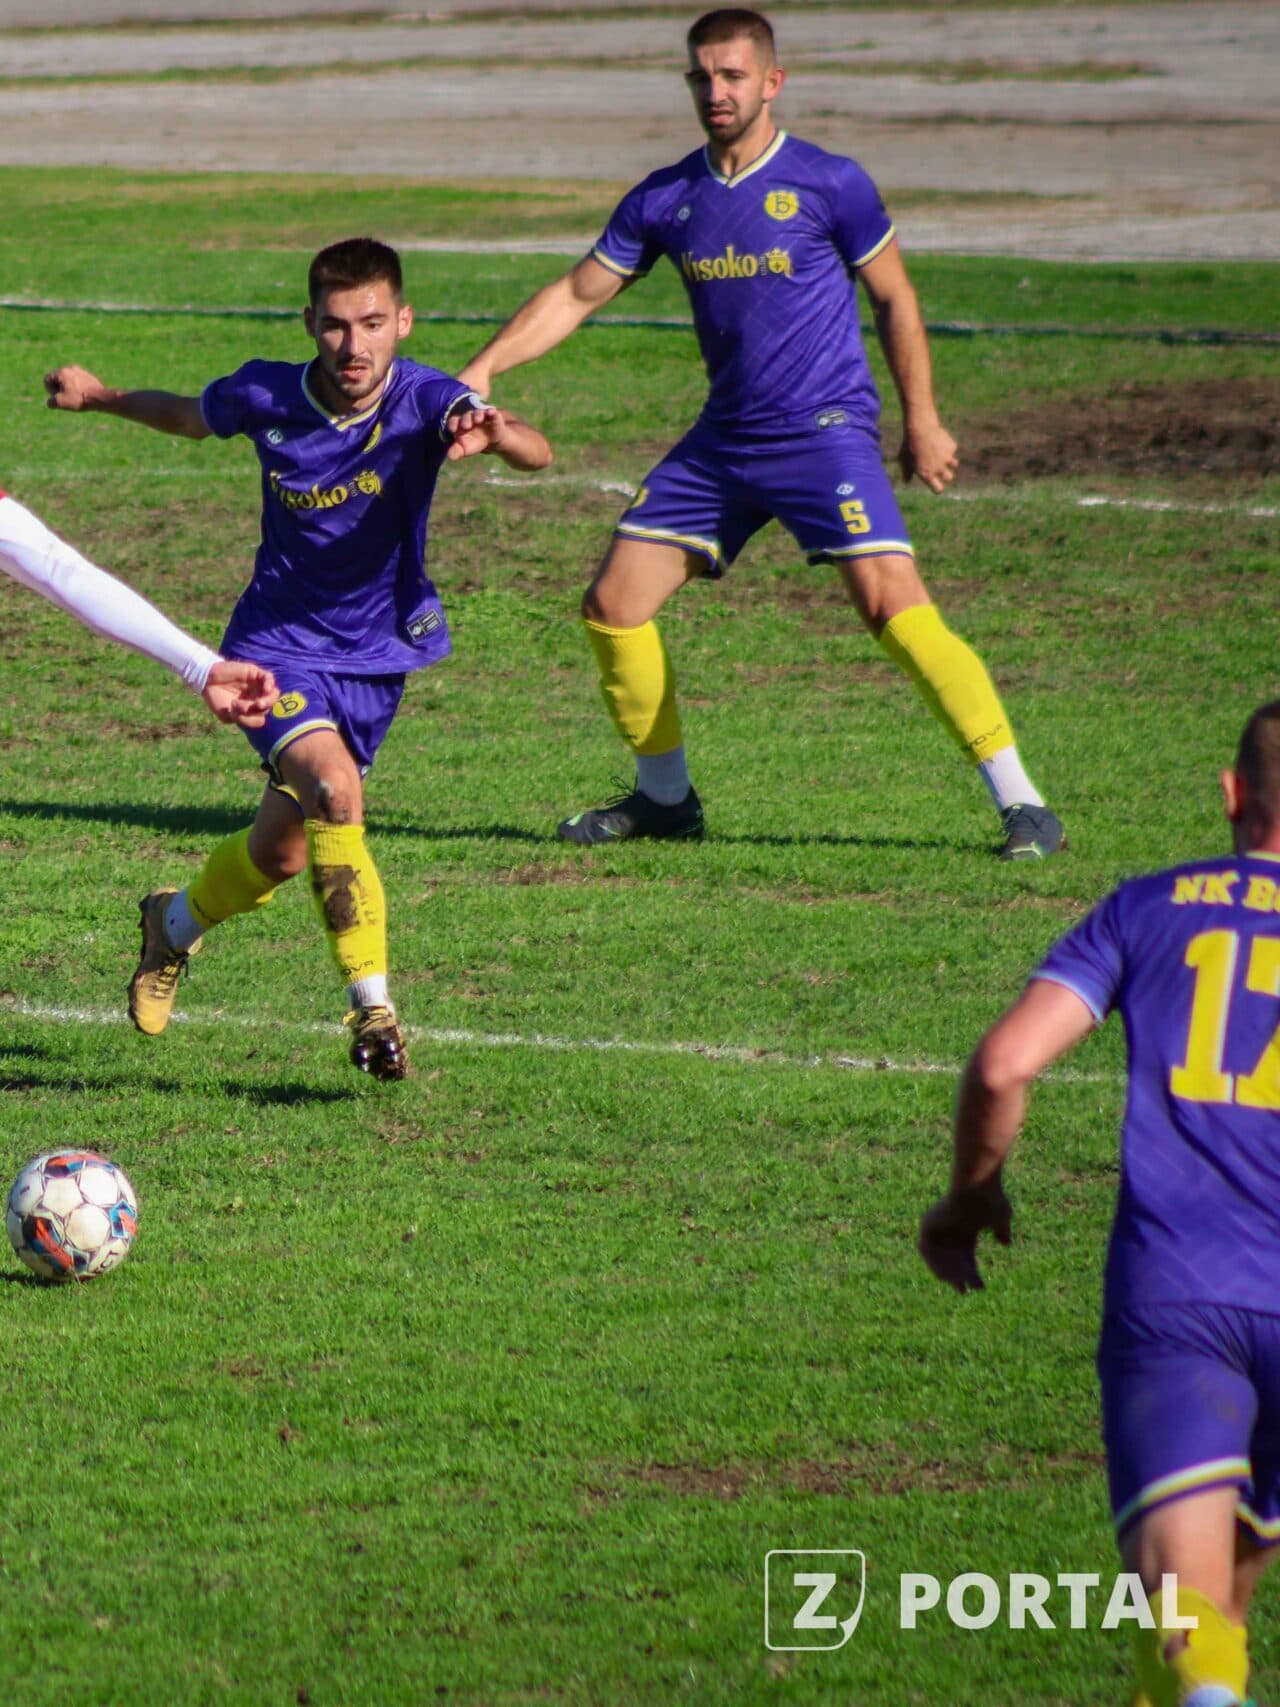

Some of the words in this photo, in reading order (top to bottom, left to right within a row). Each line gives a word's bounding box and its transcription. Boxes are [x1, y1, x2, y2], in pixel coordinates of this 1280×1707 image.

[681, 245, 758, 281] Visoko
[839, 500, 871, 534] 5
[1171, 870, 1240, 906] NK
[1242, 876, 1280, 912] B
